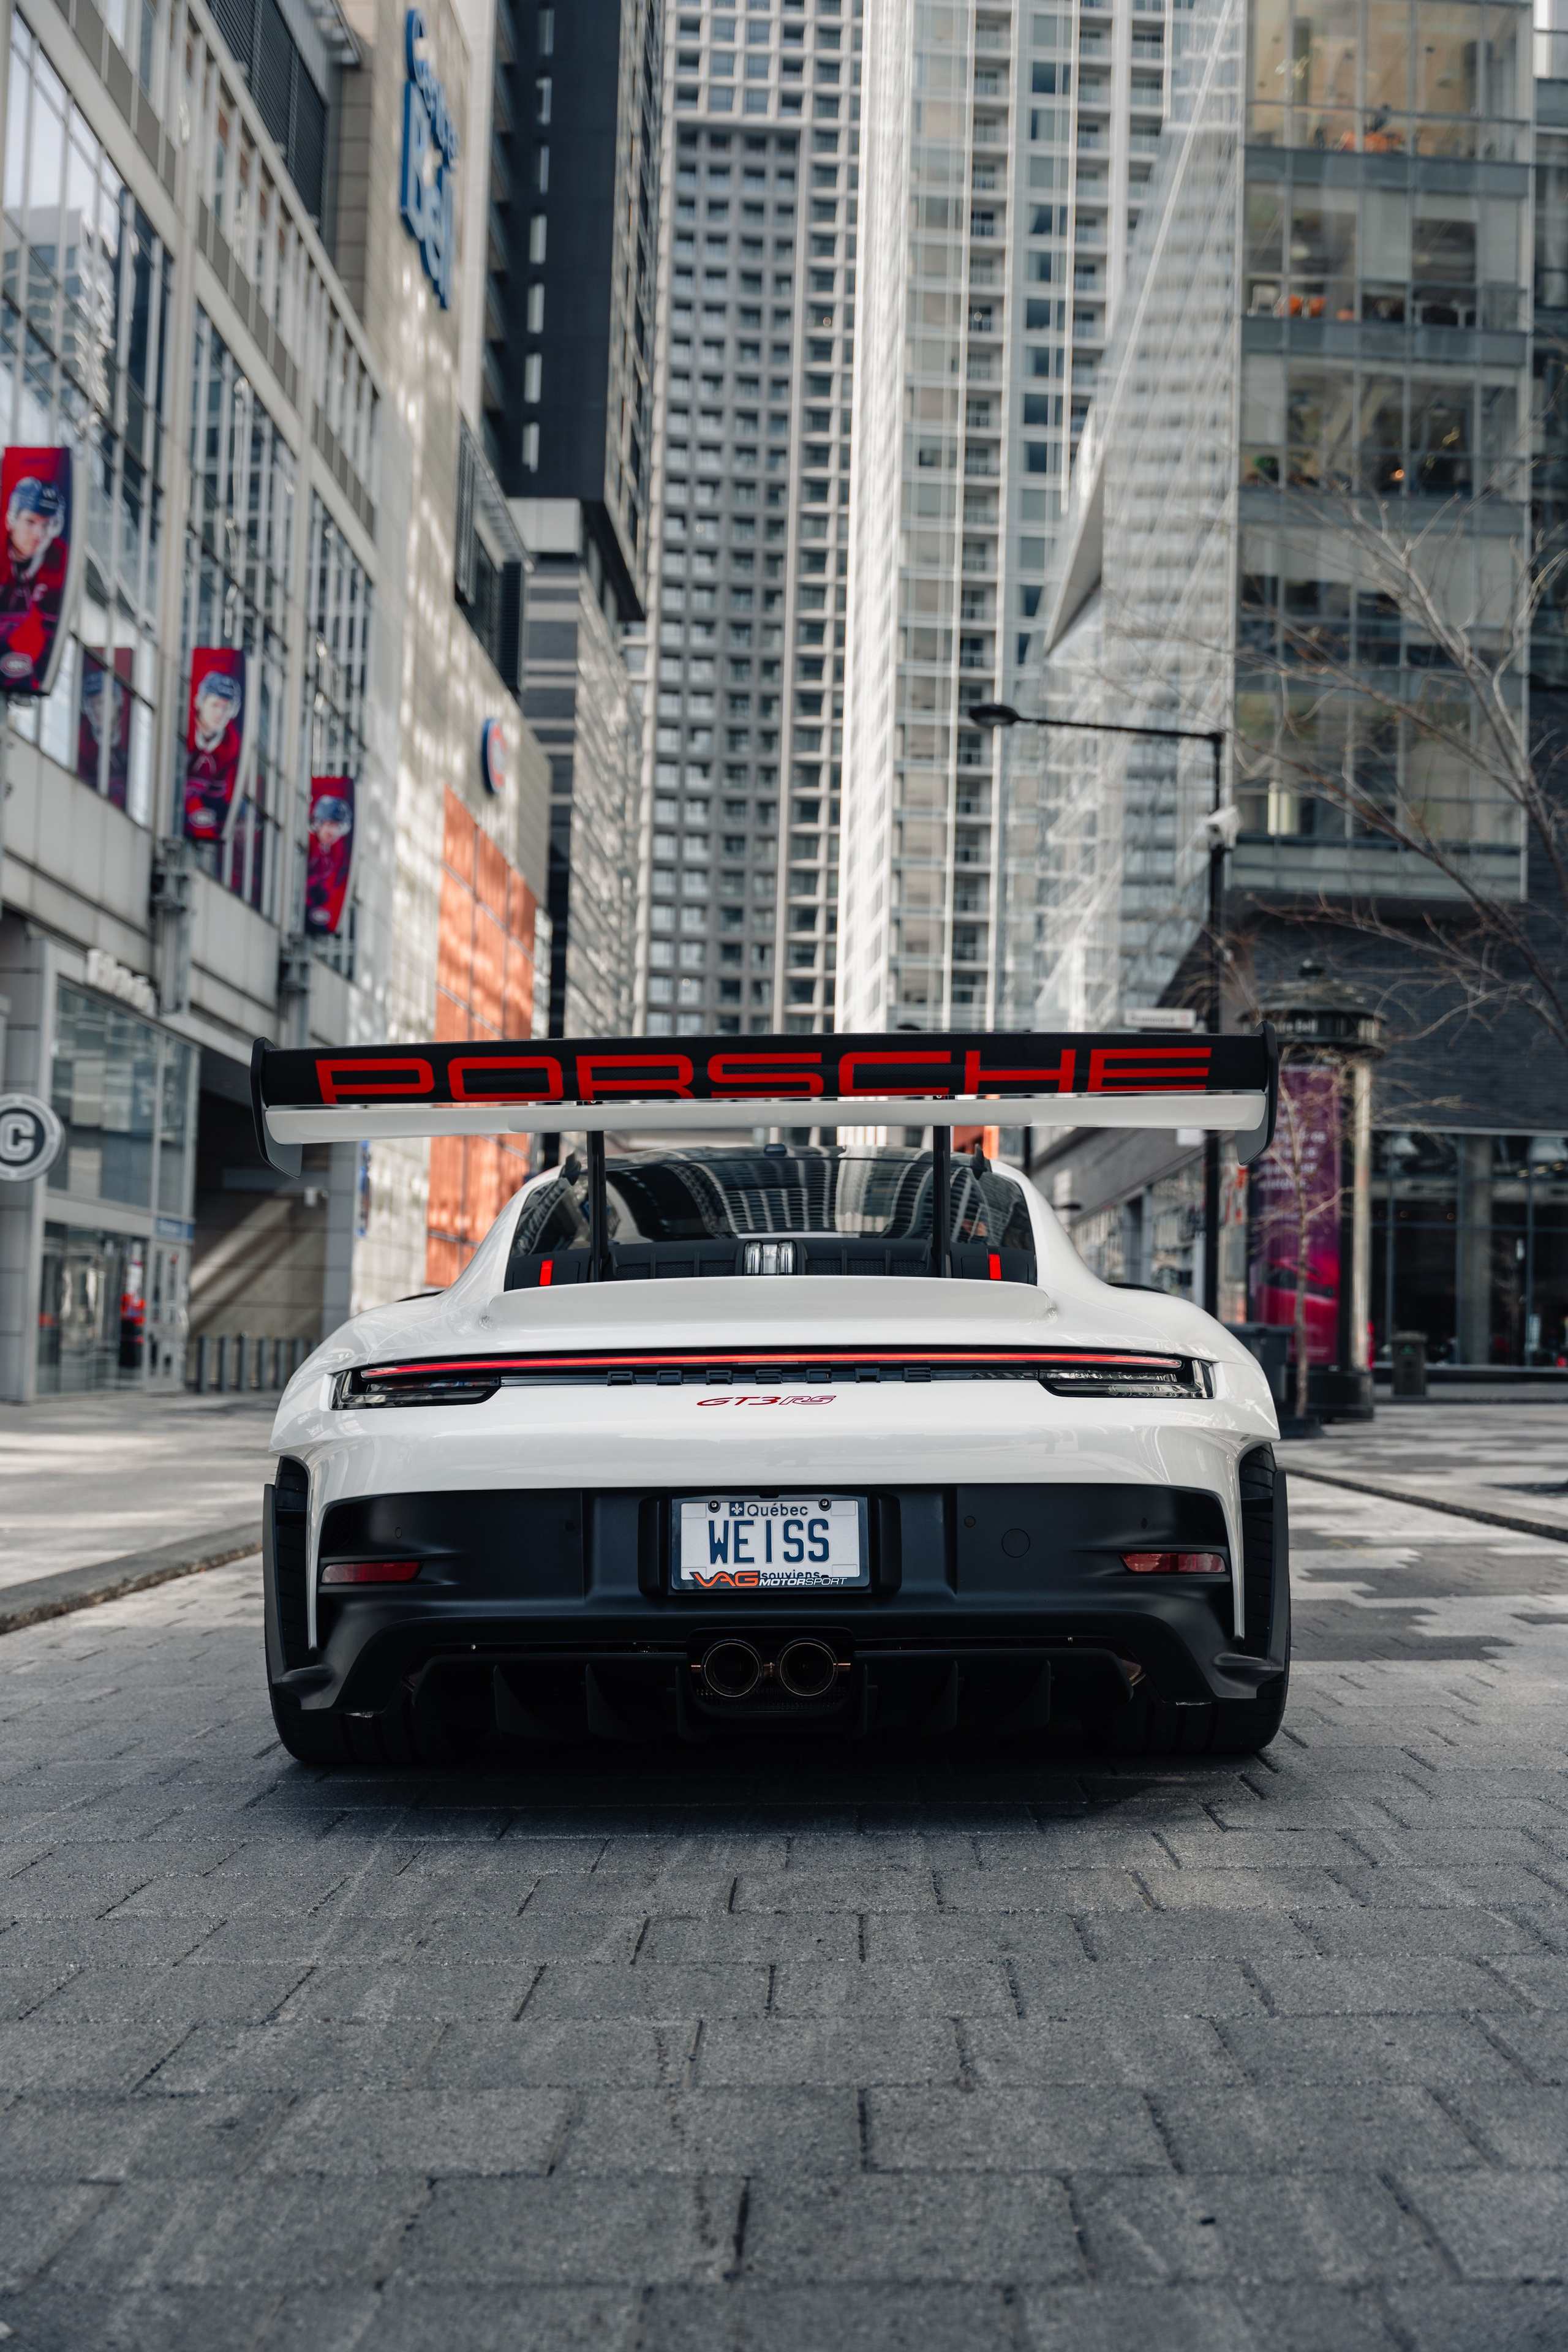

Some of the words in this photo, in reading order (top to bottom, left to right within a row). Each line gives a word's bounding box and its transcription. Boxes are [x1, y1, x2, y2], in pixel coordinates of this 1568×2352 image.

[401, 80, 456, 310] Bell
[315, 1047, 1212, 1104] PORSCHE
[0, 1113, 36, 1161] C
[607, 1366, 932, 1386] PORSCHE
[747, 1502, 809, 1518] Québec
[708, 1518, 830, 1564] WEISS
[692, 1570, 759, 1588] VAG
[758, 1577, 848, 1587] MOTORSPORT
